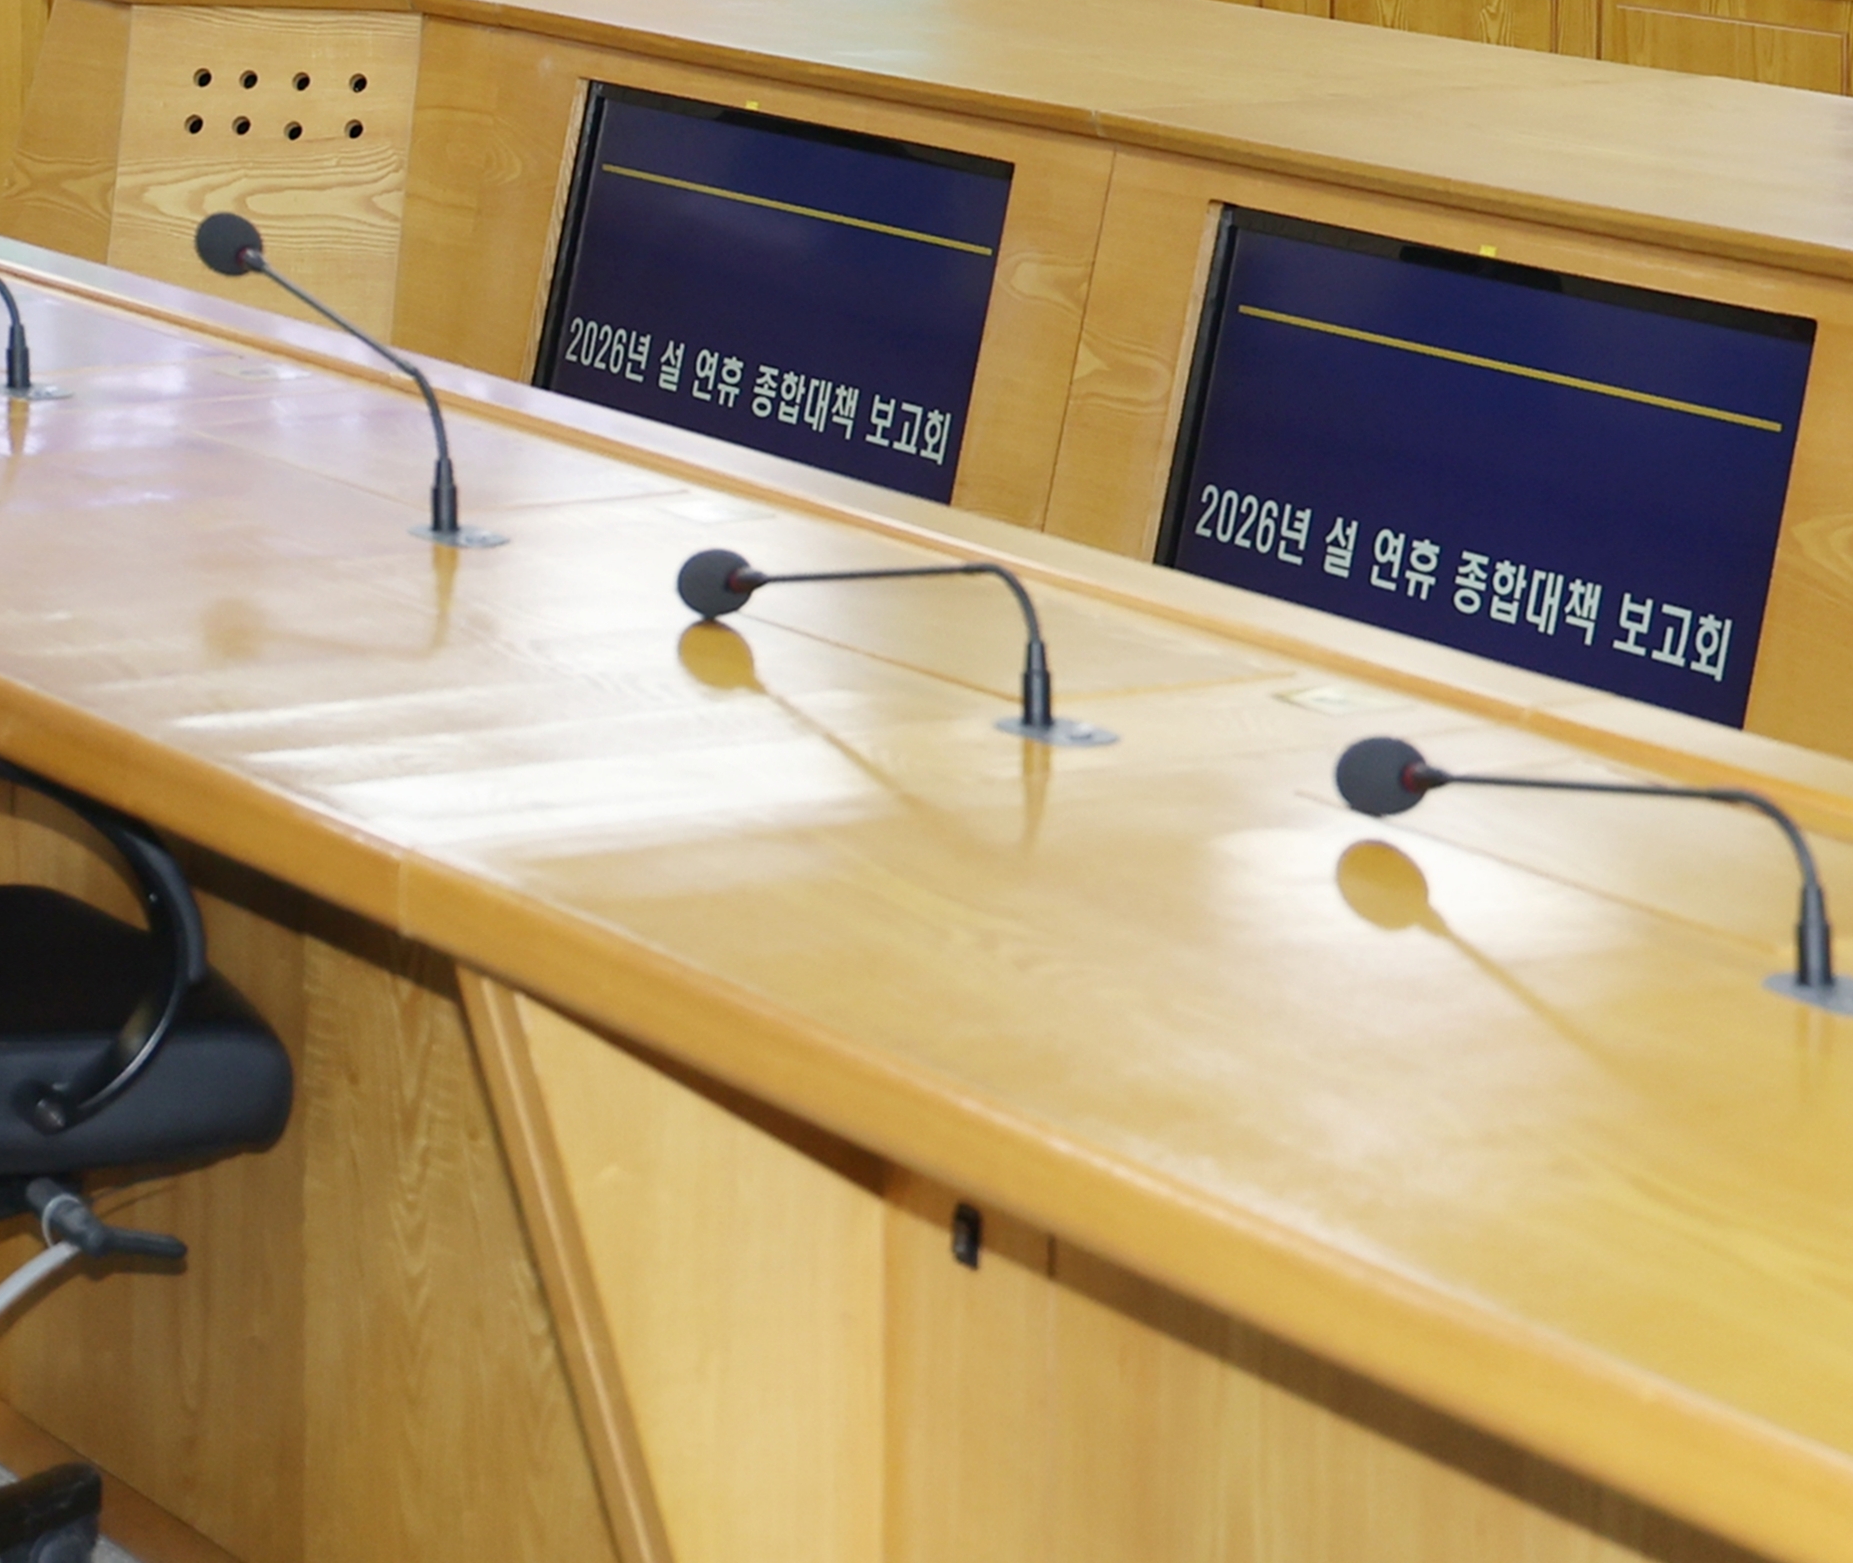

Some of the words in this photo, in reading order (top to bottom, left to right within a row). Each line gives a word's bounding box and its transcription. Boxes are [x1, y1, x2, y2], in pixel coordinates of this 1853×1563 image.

[564, 316, 651, 383] 2026년
[657, 340, 685, 392] 설
[691, 348, 745, 408] 연휴
[750, 364, 859, 440] 종합대책
[865, 394, 952, 466] 보고회
[1194, 483, 1312, 566] 2026년
[1322, 516, 1359, 579] 설
[1369, 528, 1441, 601] 연휴
[1452, 550, 1602, 646] 종합대책
[1612, 592, 1733, 683] 보고회
